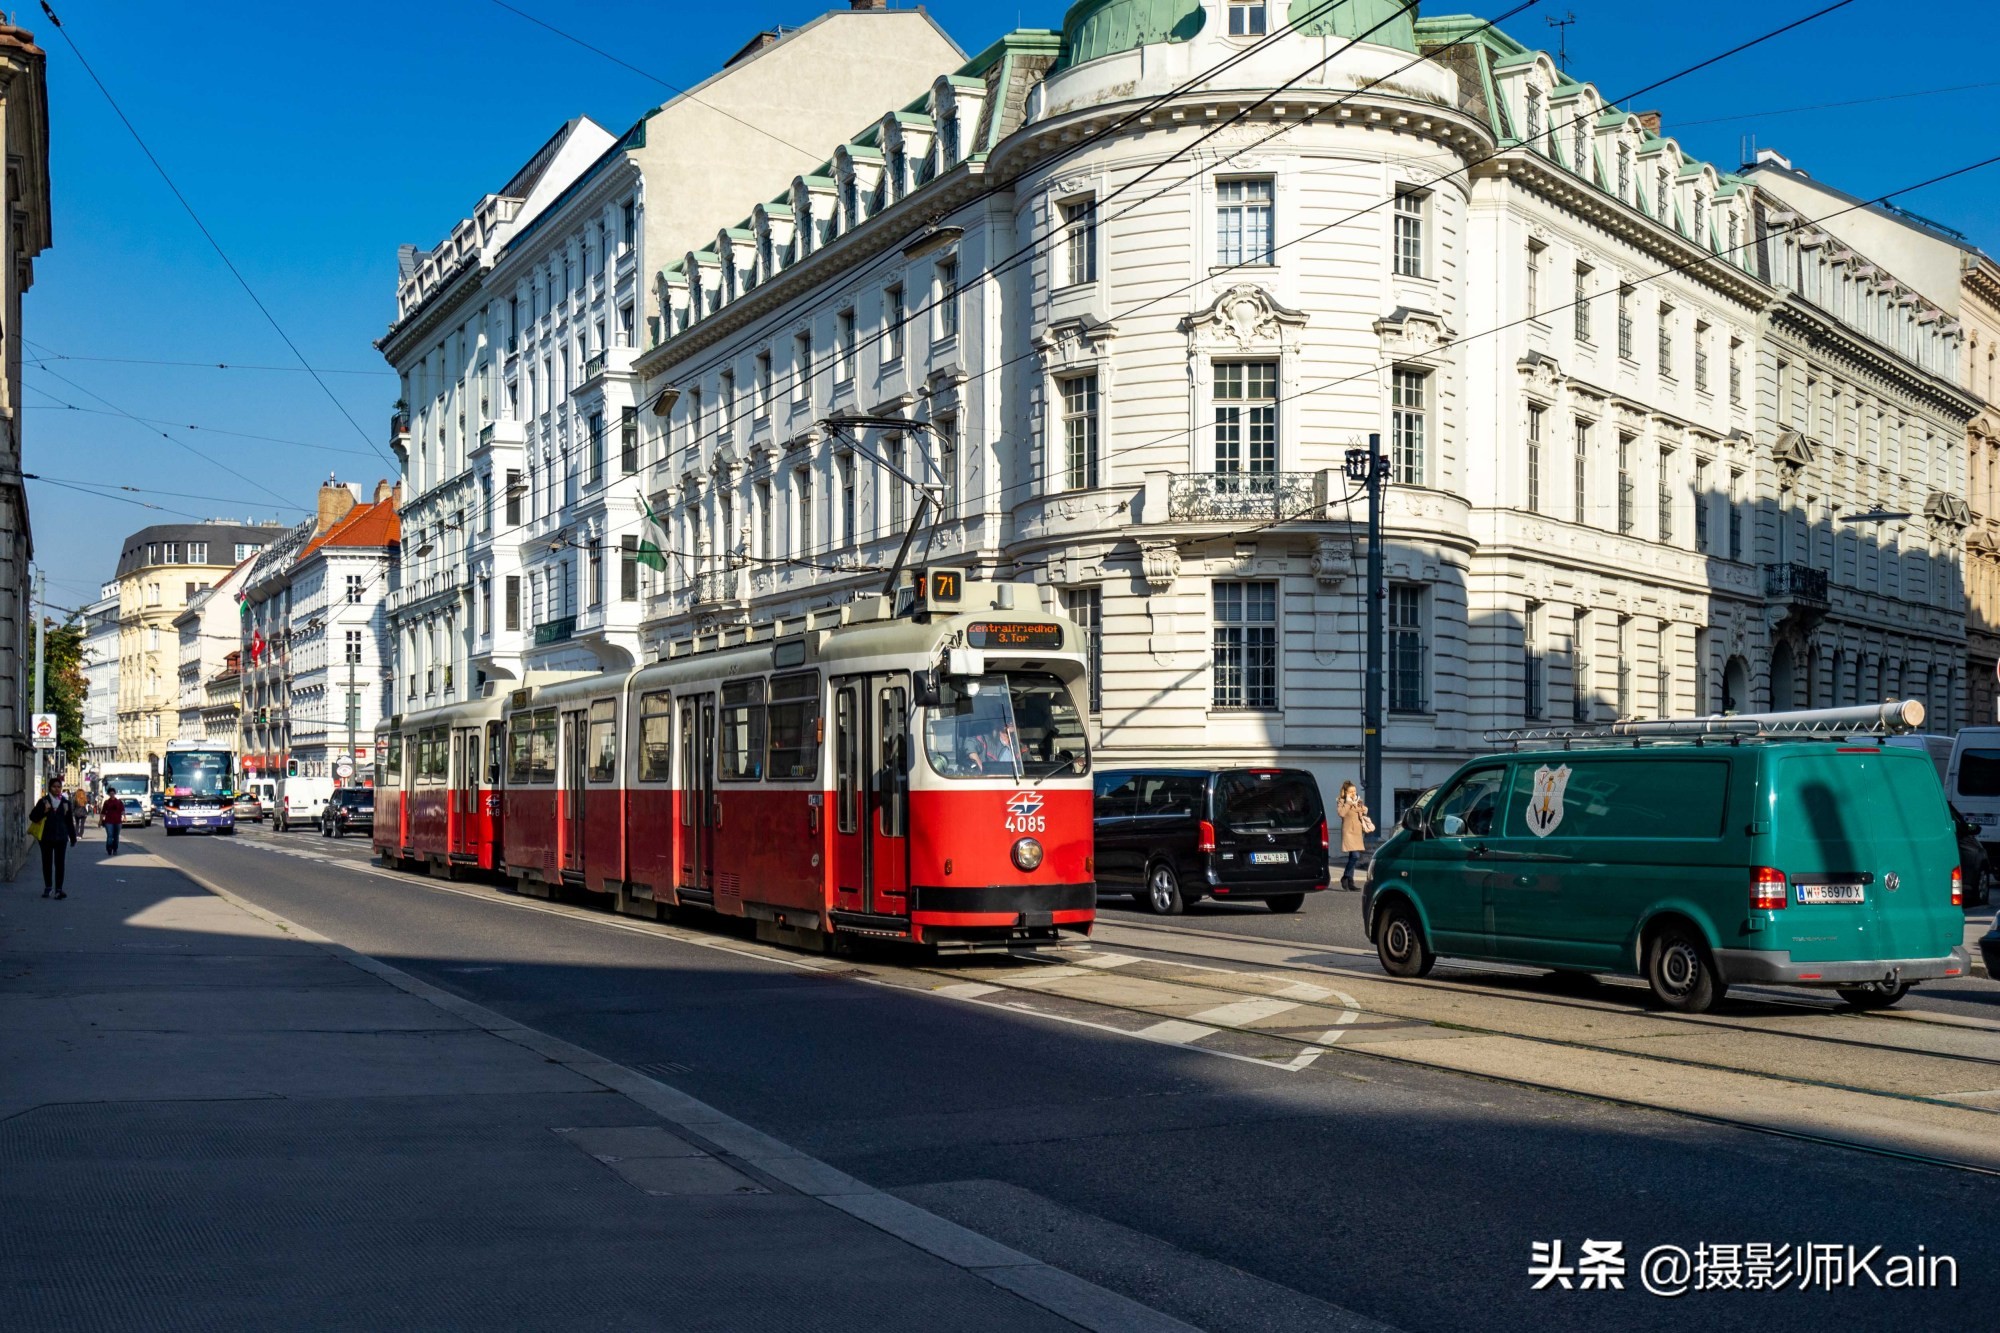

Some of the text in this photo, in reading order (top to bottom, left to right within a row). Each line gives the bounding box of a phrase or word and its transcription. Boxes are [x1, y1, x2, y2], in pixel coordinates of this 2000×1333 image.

[937, 576, 954, 596] 71
[998, 633, 1030, 643] 3. Tor
[1005, 816, 1045, 832] 4085
[1806, 886, 1861, 898] W 56970 X
